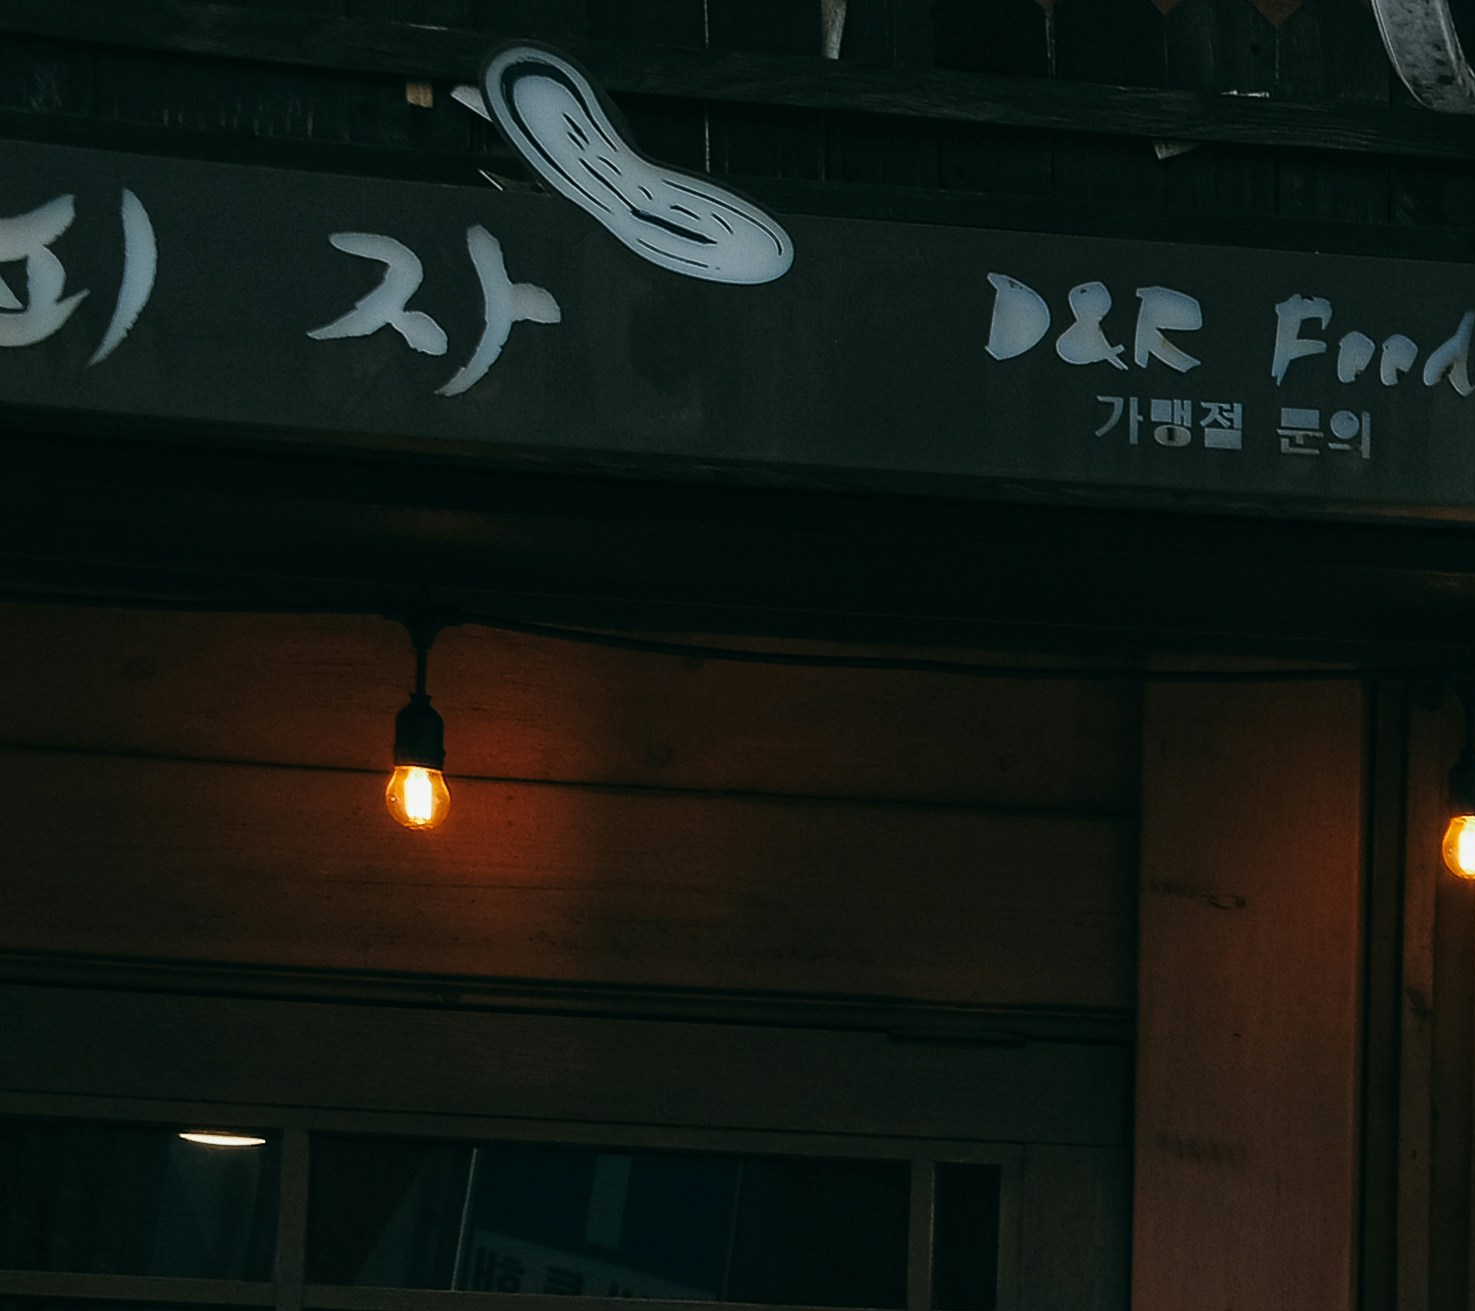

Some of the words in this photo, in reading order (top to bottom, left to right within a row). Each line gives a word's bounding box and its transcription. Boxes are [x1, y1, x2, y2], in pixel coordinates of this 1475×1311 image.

[982, 270, 1204, 374] D&R
[1094, 395, 1244, 452] 가맹점
[1276, 407, 1372, 460] 문의
